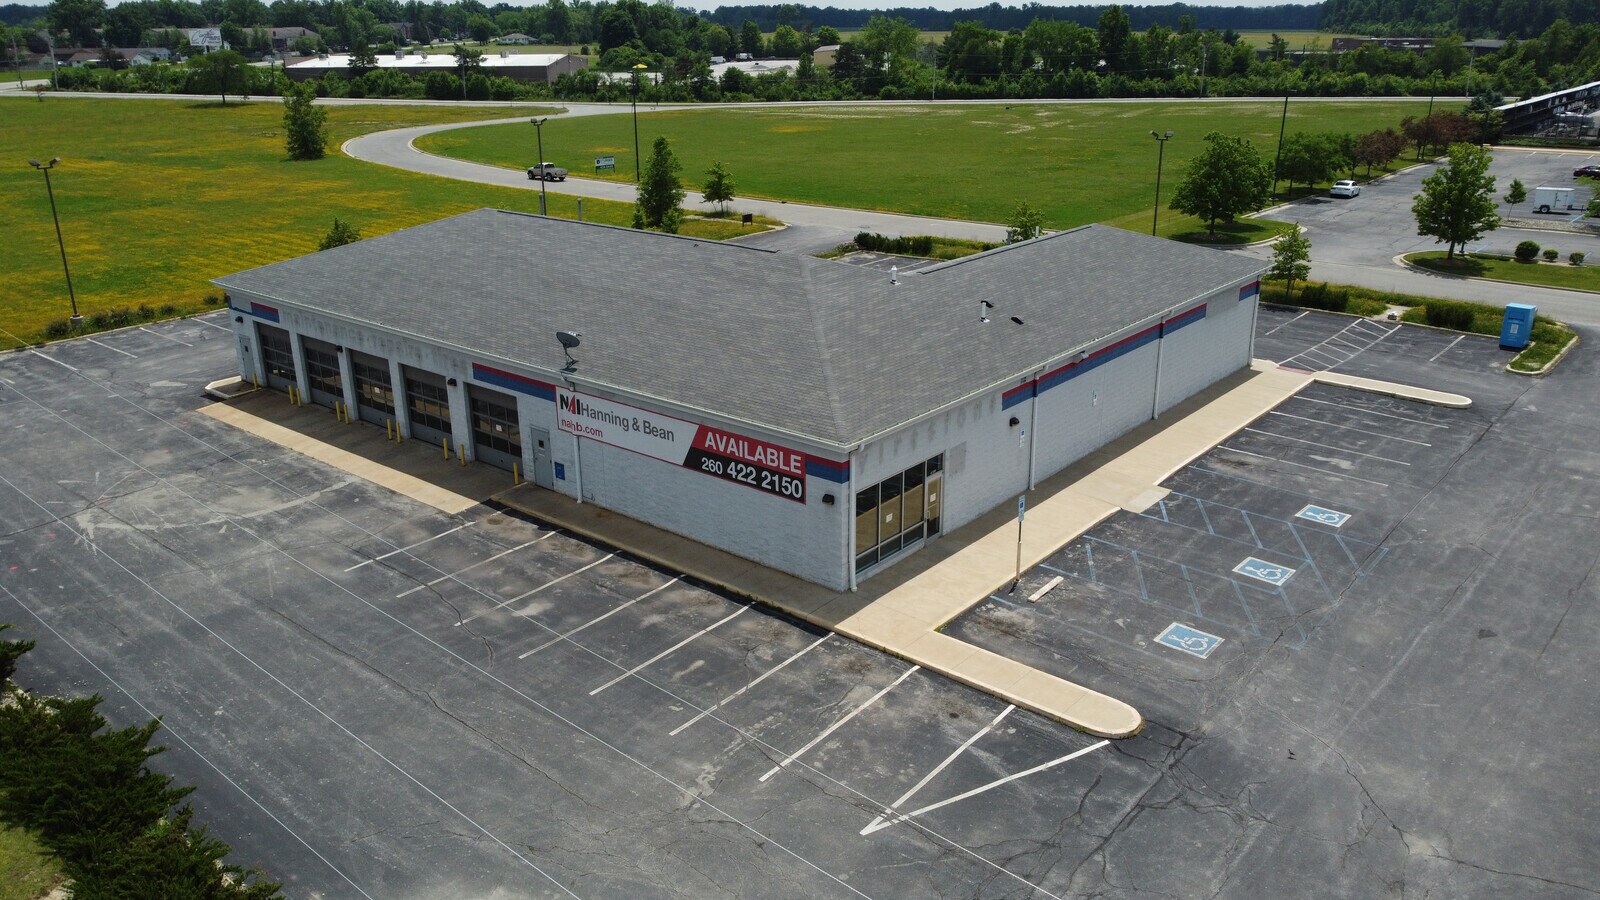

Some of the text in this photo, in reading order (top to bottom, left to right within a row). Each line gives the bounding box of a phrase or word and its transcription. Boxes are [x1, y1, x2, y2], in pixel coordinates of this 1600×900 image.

[561, 419, 603, 438] nahb.com
[581, 402, 629, 432] Hanning
[632, 417, 641, 432] &
[643, 420, 674, 441] Bean
[704, 431, 801, 474] AVAILABLE
[701, 457, 802, 498] 260 422 2150
